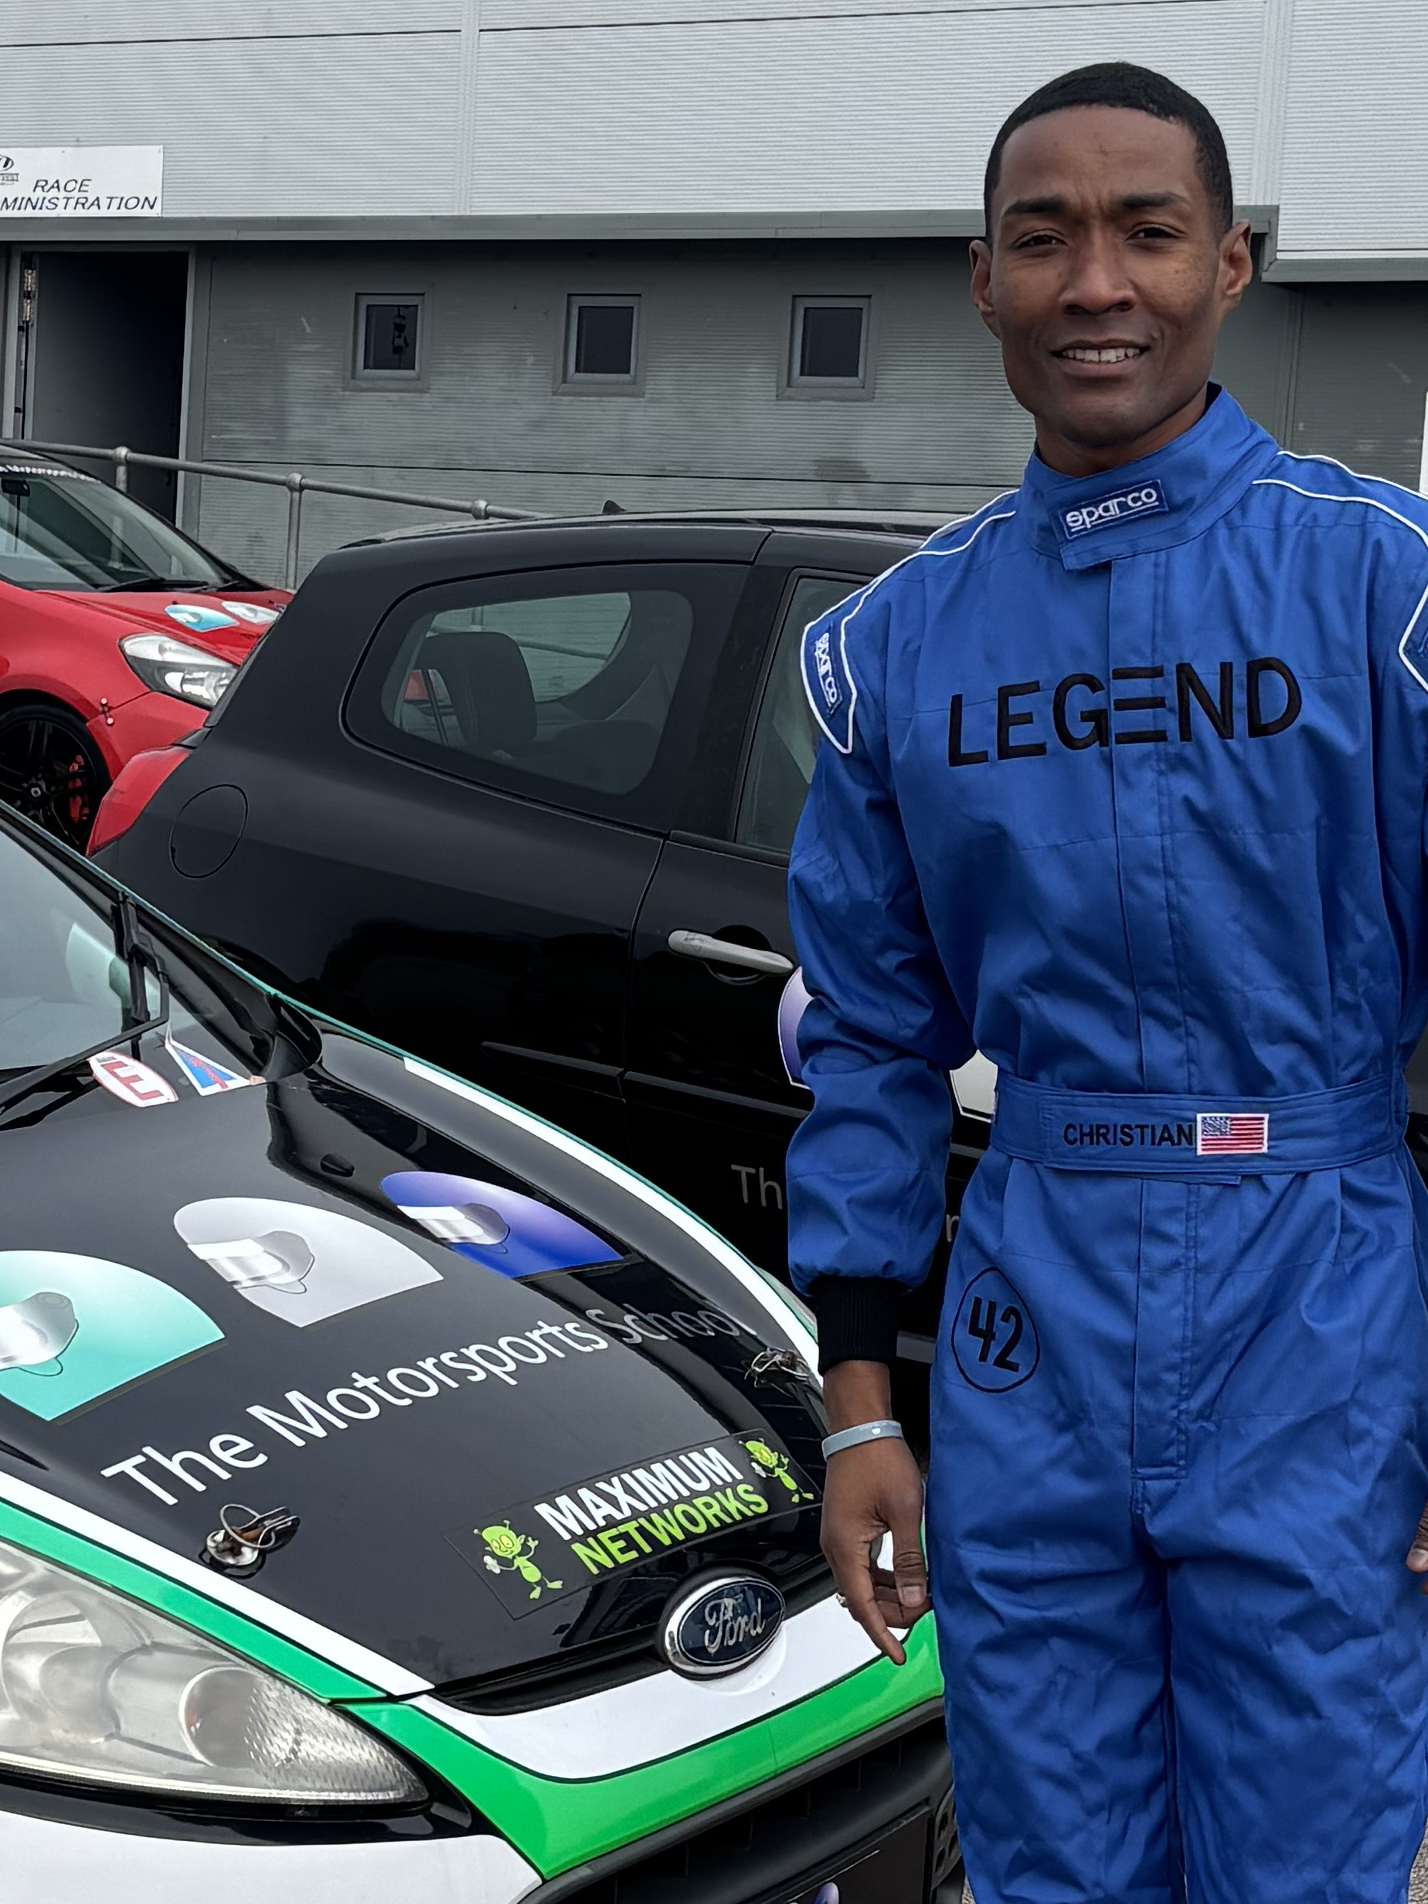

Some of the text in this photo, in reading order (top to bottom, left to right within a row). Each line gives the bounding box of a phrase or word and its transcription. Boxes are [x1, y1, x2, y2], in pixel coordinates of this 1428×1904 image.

[32, 178, 92, 193] RACE
[948, 656, 1302, 768] LEGEND
[1063, 1122, 1195, 1147] CHRISTIAN
[730, 1164, 784, 1211] Th
[968, 1296, 1024, 1373] 42
[100, 1301, 758, 1506] The Motorsports School
[534, 1446, 744, 1541] MAXIMUM
[570, 1483, 769, 1575] NETWORKS
[703, 1590, 766, 1656] Ford
